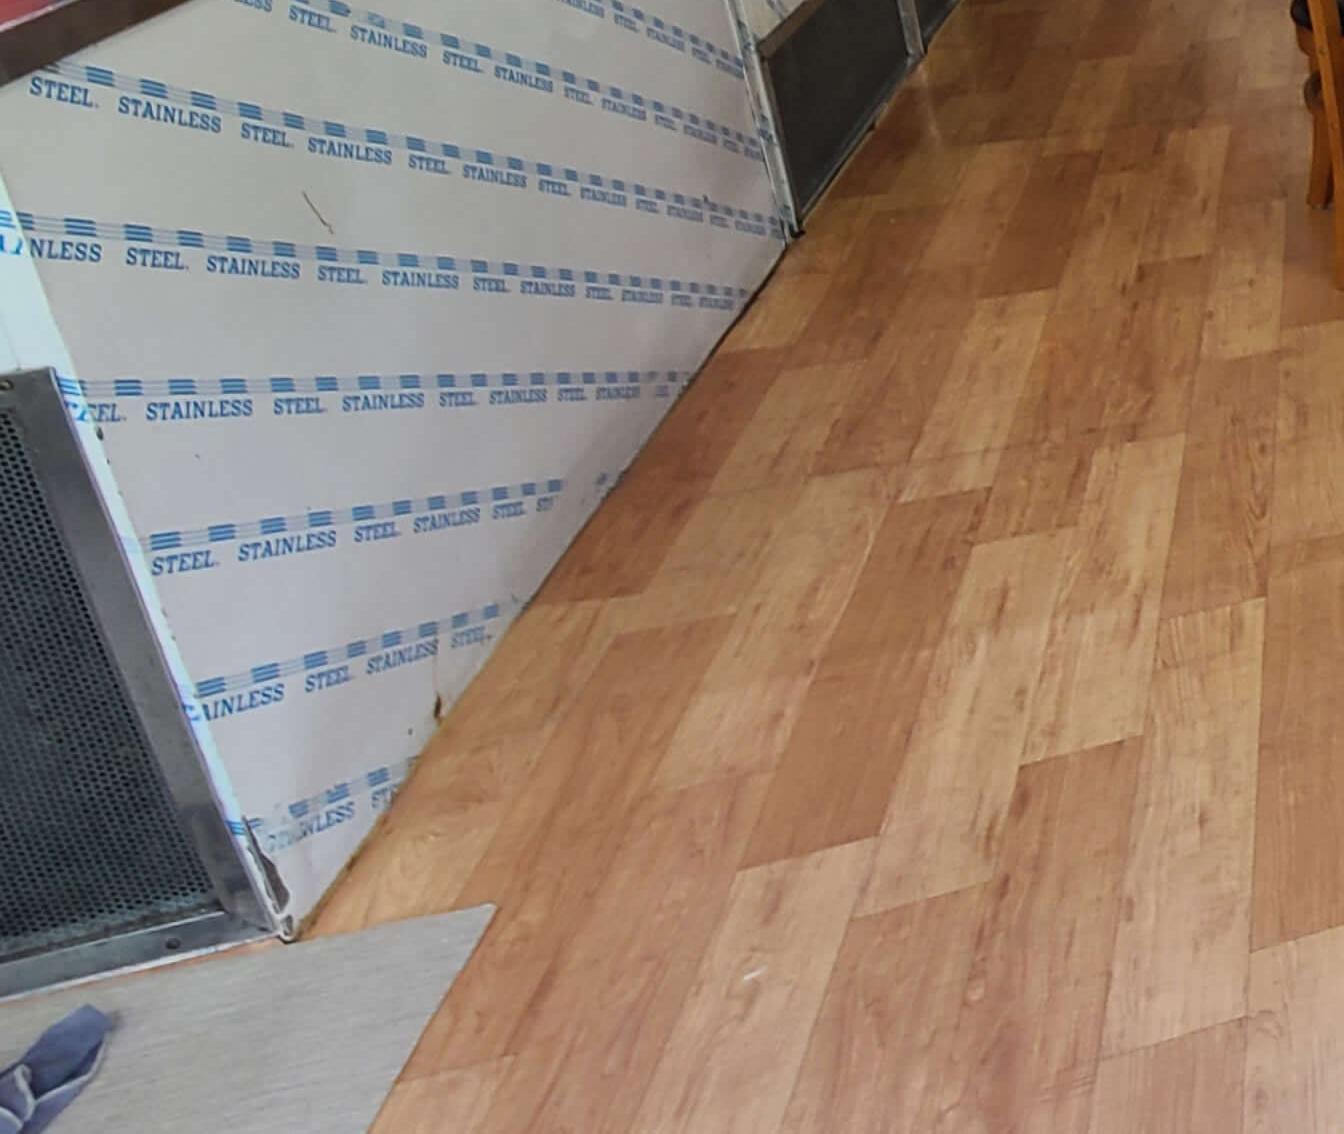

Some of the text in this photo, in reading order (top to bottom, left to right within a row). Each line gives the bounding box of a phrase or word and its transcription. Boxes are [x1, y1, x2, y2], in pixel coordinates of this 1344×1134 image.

[117, 95, 222, 134] STAINLESS
[307, 137, 393, 166] STAINLESS
[206, 254, 300, 279] STAINLESS
[382, 268, 459, 290] STAINLESS
[146, 399, 253, 422] STAINLESS
[342, 391, 424, 414] STAINLESS
[237, 530, 336, 563] STAINLESS
[413, 507, 481, 534] STAINLESS
[365, 638, 439, 676] STAINLESS
